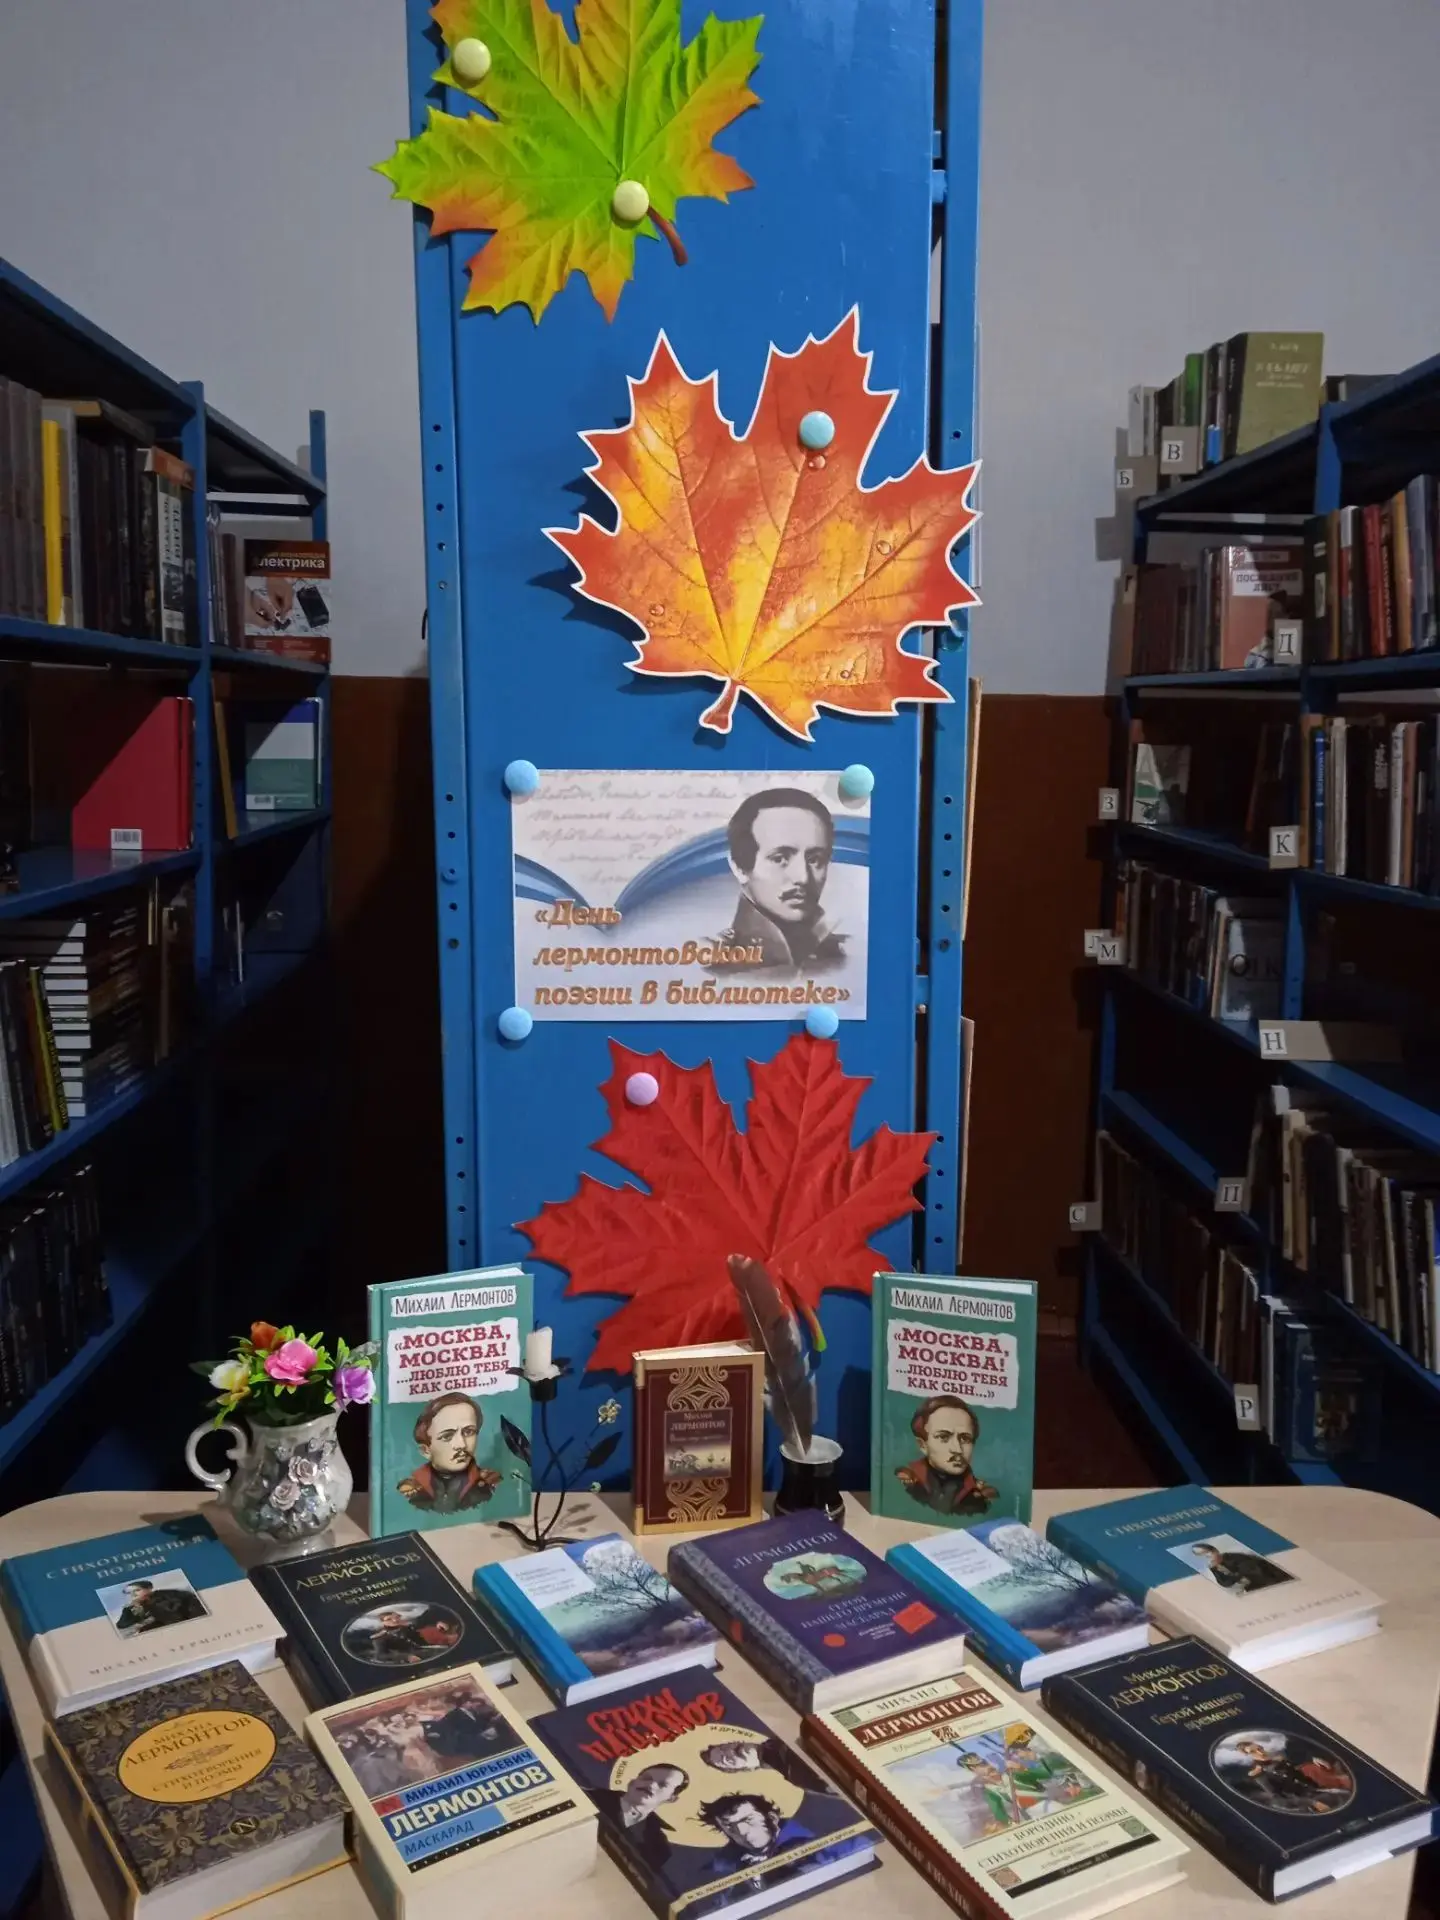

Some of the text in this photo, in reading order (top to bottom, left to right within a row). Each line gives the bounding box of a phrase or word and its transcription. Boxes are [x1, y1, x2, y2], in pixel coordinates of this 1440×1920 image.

[1167, 443, 1181, 461] В
[1119, 470, 1130, 486] Б
[252, 556, 325, 571] лектрика
[1277, 633, 1293, 657] Д
[1275, 833, 1291, 855] К
[535, 899, 622, 929] «День
[533, 938, 764, 971] лермонтовской
[1101, 943, 1116, 959] М
[534, 979, 851, 1006] поэзии в библиотеке»
[1262, 1032, 1284, 1053] Н
[1222, 1186, 1240, 1204] П
[1071, 1208, 1084, 1223] С
[394, 1324, 511, 1351] «МОСКВА,
[894, 1327, 1010, 1357] «МОСКВА,
[399, 1342, 507, 1368] МОСКВА!
[474, 1360, 509, 1374] ТЕБЯ
[898, 1345, 1005, 1372] МОСКВА!
[409, 1381, 441, 1395] КАК
[907, 1377, 939, 1391] КАК
[971, 1372, 1008, 1388] ТЕБЯ
[1240, 1399, 1253, 1419] Р
[1104, 1503, 1221, 1538] СТИХОТВОРЕНИЯ
[1151, 1521, 1206, 1541] ПОЭМЫ
[731, 1531, 838, 1569] ЛЕРМОНТОВ
[95, 1555, 168, 1579] ПОЭМЫ
[295, 1551, 421, 1591] ЛЕРМОНТОВ
[875, 1685, 940, 1714] МИХАИЛ
[1110, 1663, 1229, 1710] ЛЕРМОНТОВ
[861, 1691, 994, 1745] ЛЕРМОНТОВ
[1150, 1690, 1245, 1727] Герой нашего
[1183, 1707, 1243, 1731] времени
[125, 1716, 253, 1768] ЛЕРМОНТОВ
[152, 1721, 214, 1746] МИХАИЛ
[152, 1748, 263, 1793] СТИХОТВОРЕНИЯ
[192, 1763, 243, 1787] ПОЭМЫ
[404, 1752, 534, 1803] МИХАИЛ ЮРЬЕВИЧ
[391, 1764, 549, 1837] ЛЕРМОНТОВ
[403, 1820, 475, 1857] МАСКАРАД
[1014, 1814, 1075, 1843] БОРОДИНО
[978, 1825, 1076, 1869] СТИХОТВОРЕНИЯ
